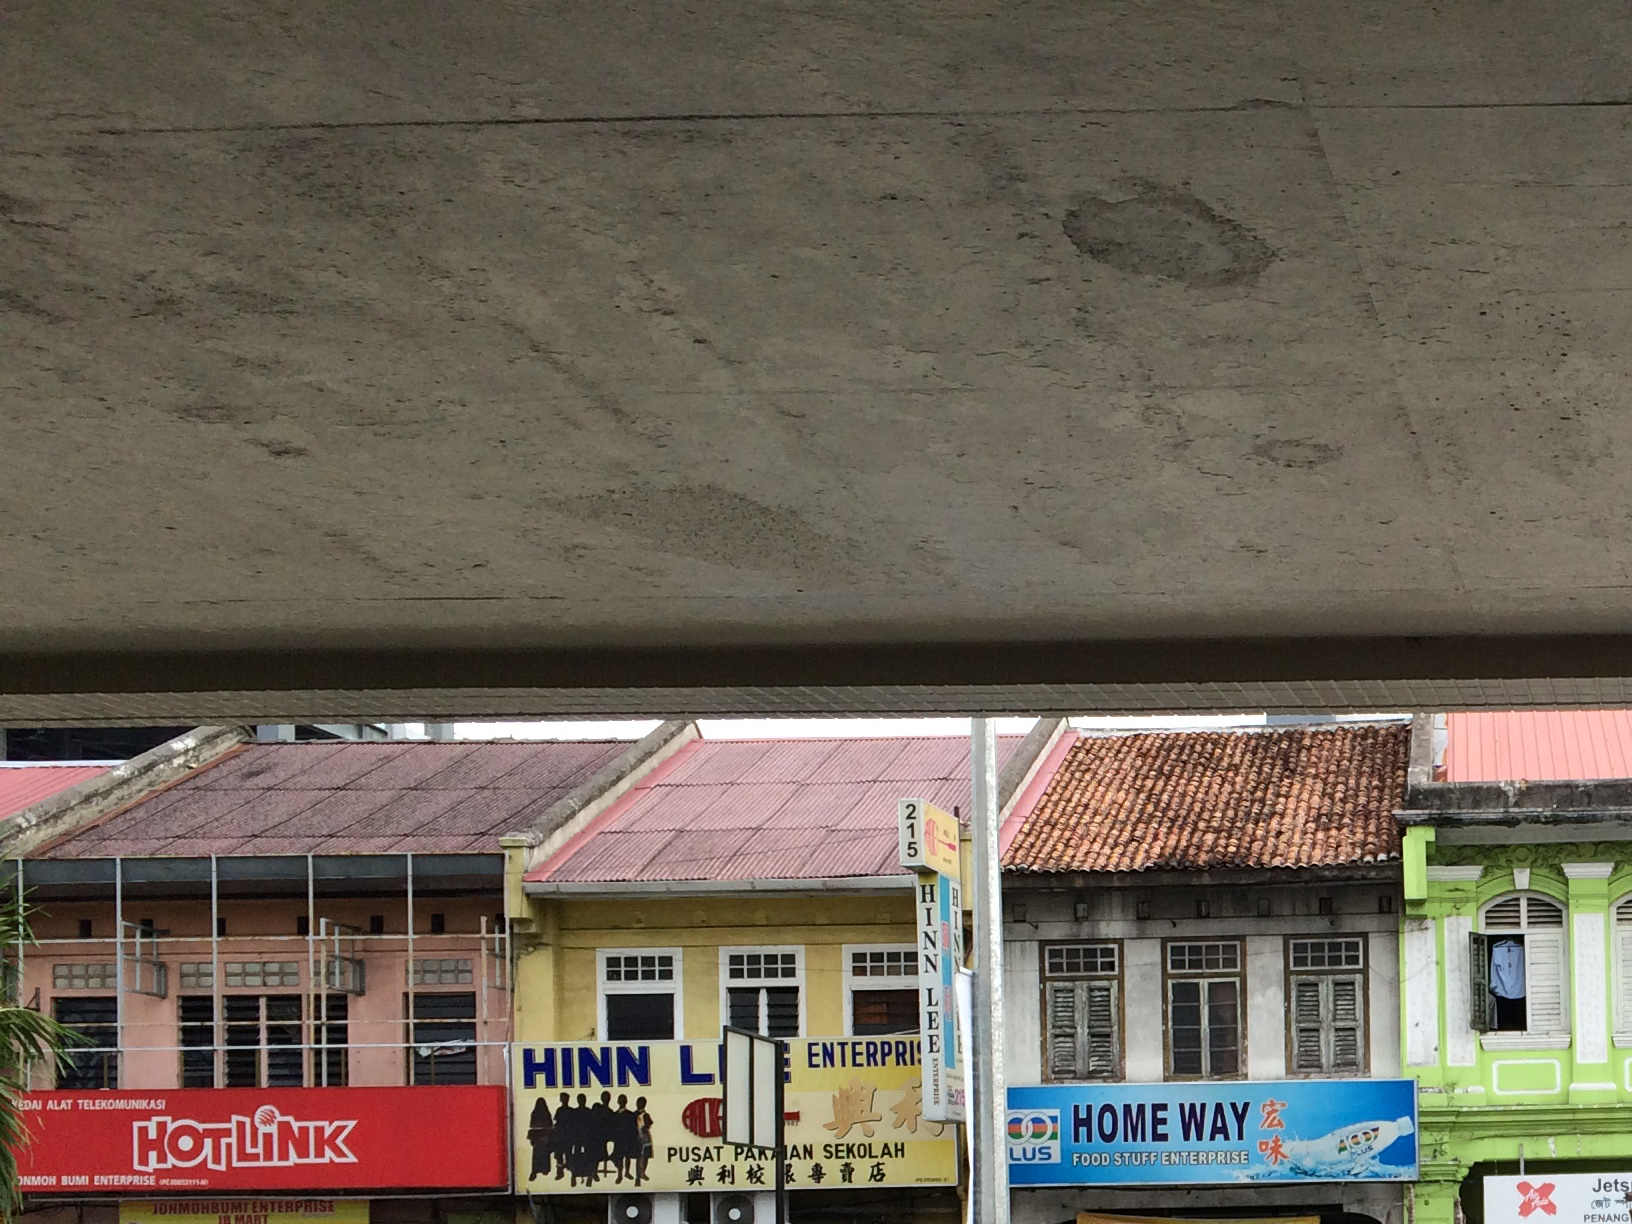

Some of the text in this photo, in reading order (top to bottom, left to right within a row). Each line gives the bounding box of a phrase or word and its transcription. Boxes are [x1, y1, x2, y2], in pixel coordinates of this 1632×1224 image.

[905, 803, 918, 858] 215
[920, 883, 940, 1054] HINN LEE
[522, 1045, 651, 1089] HINN
[932, 1058, 940, 1106] ENTERPRISE
[47, 1099, 73, 1110] ALAT
[77, 1099, 166, 1110] TELEKOMUNIKASI
[1073, 1101, 1251, 1143] HOME WAY
[667, 1145, 724, 1163] PUSAT
[823, 1142, 905, 1160] SEKOLAH
[1009, 1146, 1052, 1162] LUS
[1072, 1149, 1249, 1166] FOOD STUFF ENTERPRISE
[17, 1175, 56, 1186] ONMOH
[61, 1175, 89, 1186] BUMI
[93, 1175, 156, 1186] ENTERPRISE
[153, 1200, 336, 1215] JONMOHBUMI ENTERPRISE
[1584, 1213, 1629, 1223] PENANG
